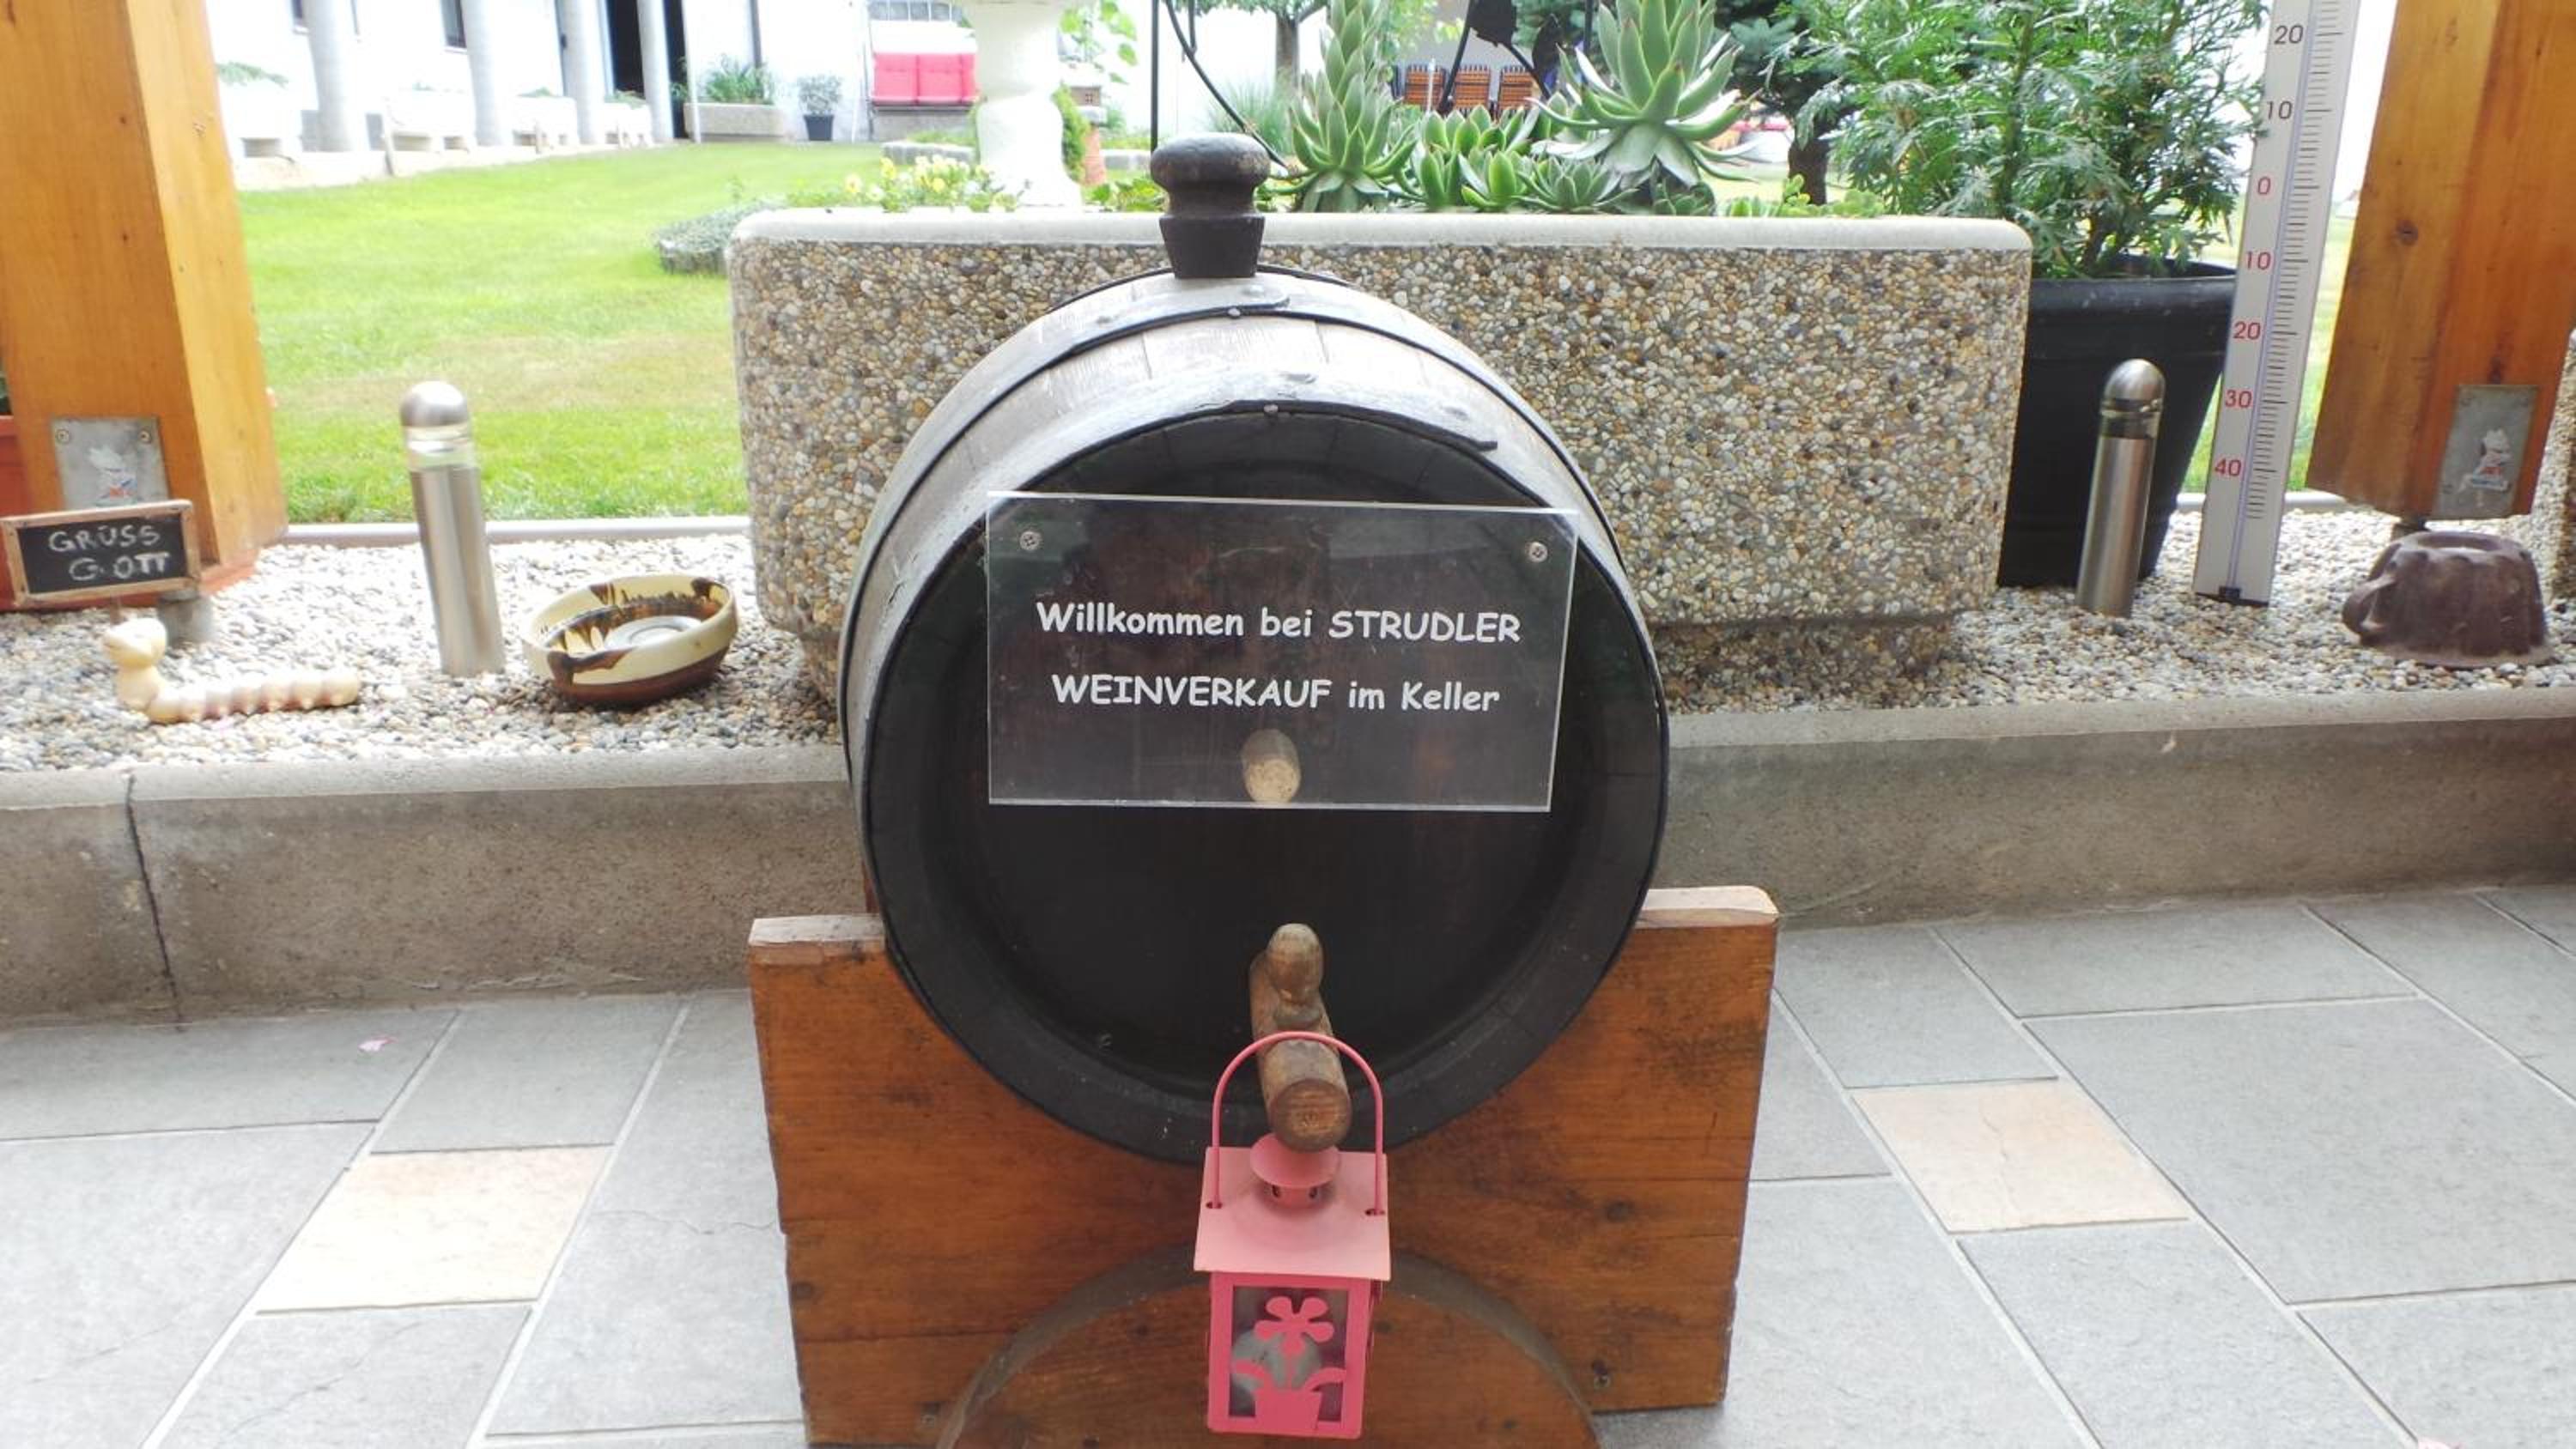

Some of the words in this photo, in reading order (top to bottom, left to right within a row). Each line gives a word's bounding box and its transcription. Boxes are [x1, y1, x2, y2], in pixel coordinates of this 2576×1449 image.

[2274, 24, 2304, 45] 20
[2267, 100, 2293, 120] 10
[2257, 176, 2271, 196] 0
[2245, 252, 2271, 270] 10
[2233, 321, 2261, 341] 20
[2225, 390, 2253, 409] 30
[2214, 458, 2242, 477] 40
[1036, 601, 1245, 637] Willkommen
[1260, 606, 1314, 638] bei
[1327, 609, 1522, 643] STRUDLER
[1051, 673, 1333, 709] WEINVERKAUF
[1347, 681, 1386, 710] im
[1400, 682, 1501, 712] Keller
